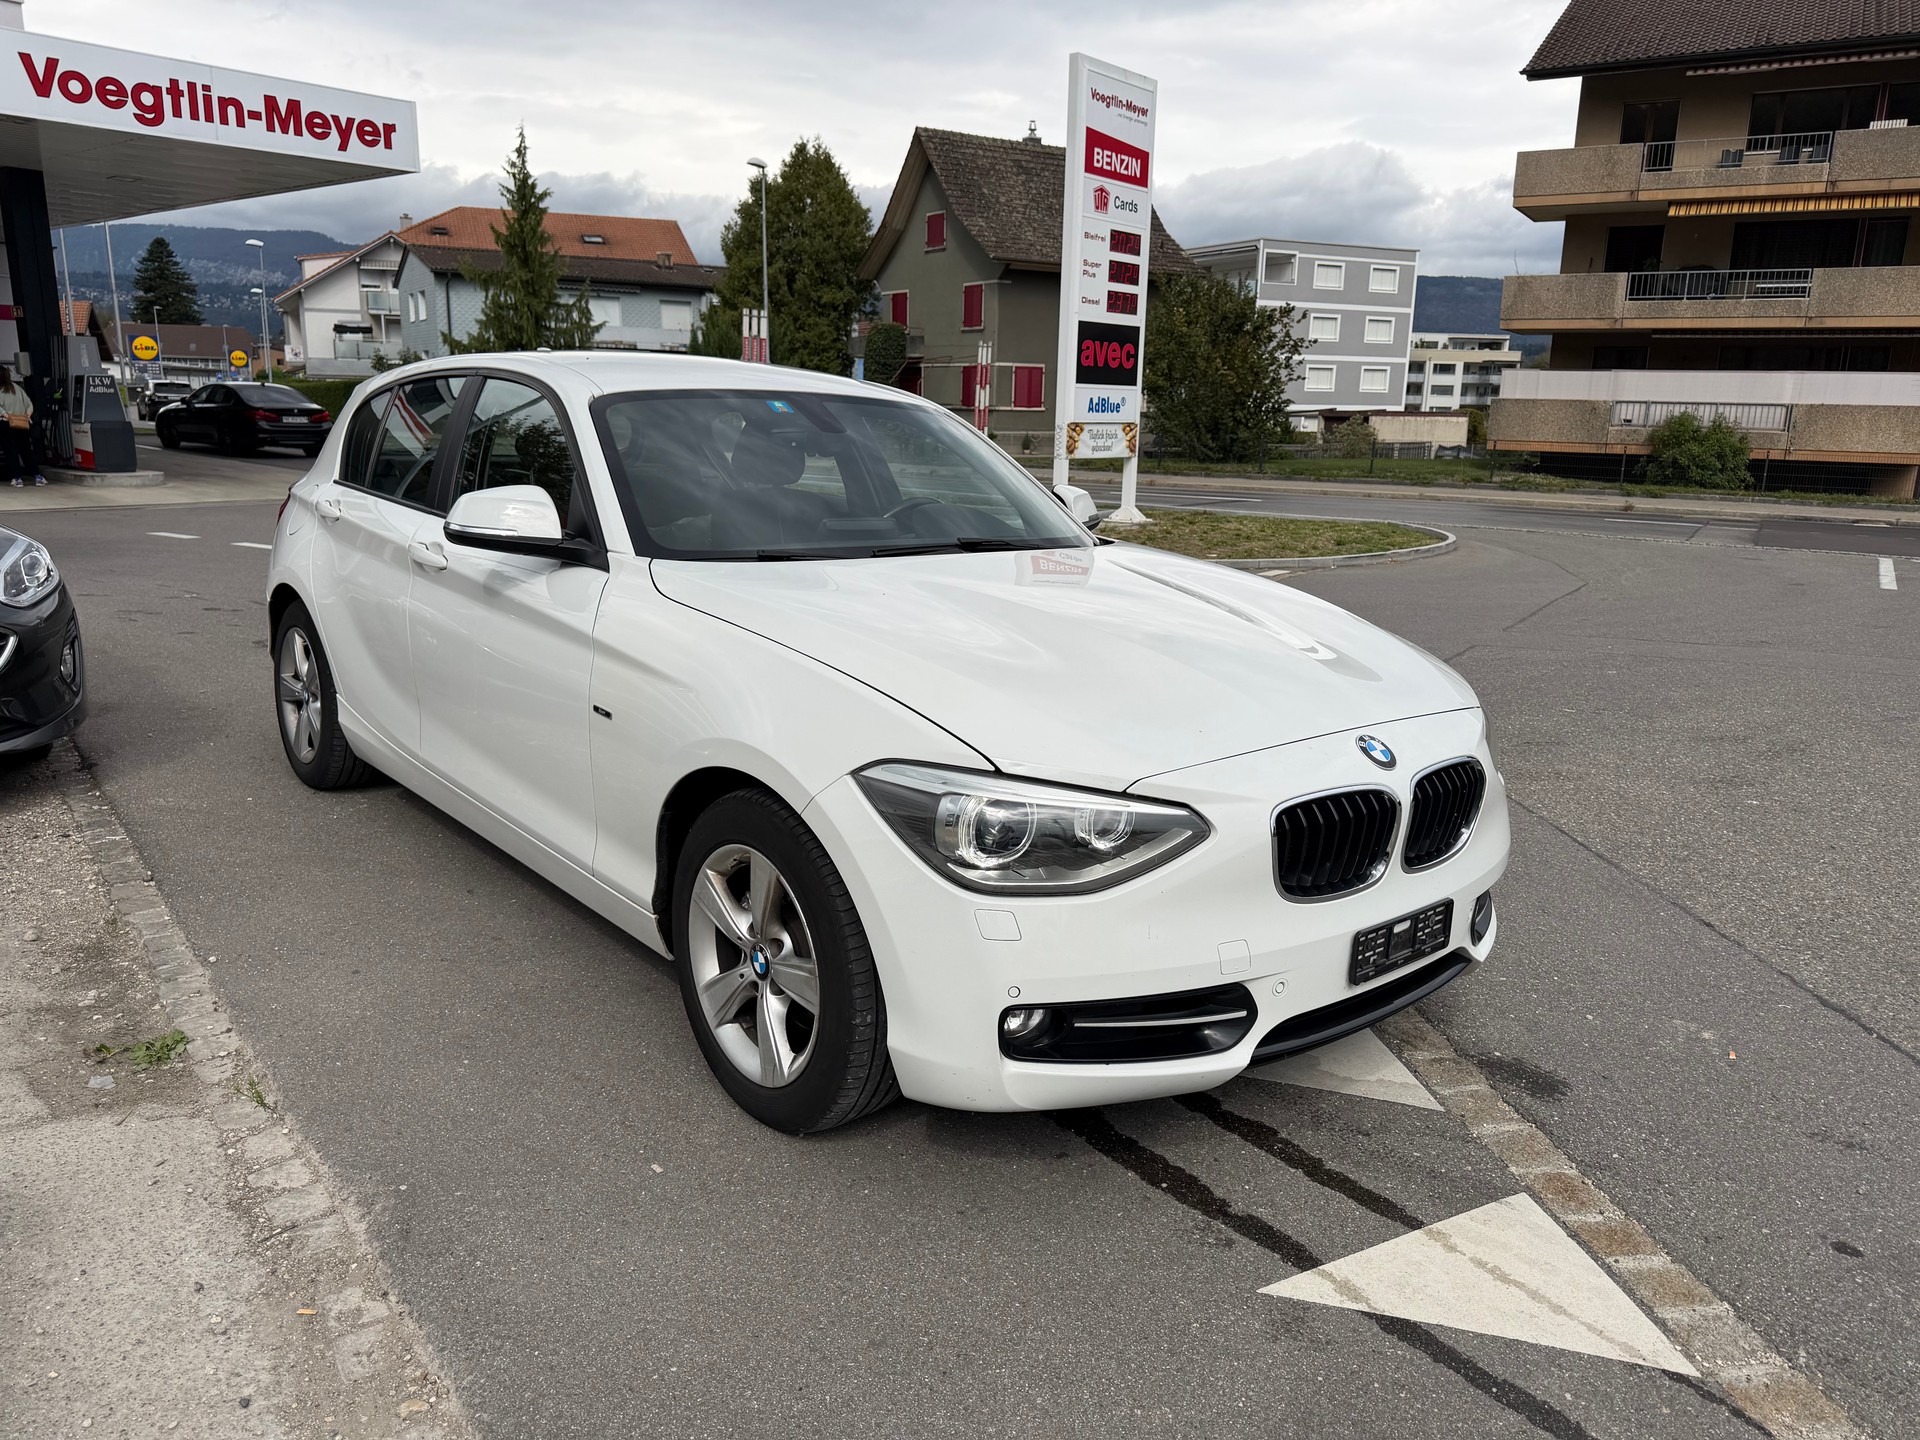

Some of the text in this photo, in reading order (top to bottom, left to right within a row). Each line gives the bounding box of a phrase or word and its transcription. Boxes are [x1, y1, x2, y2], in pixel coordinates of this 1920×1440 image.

[17, 51, 397, 152] Voegtlin-Meyer
[1090, 87, 1149, 118] Voegtlin-Meyer
[1093, 147, 1141, 178] BENZIN
[1113, 195, 1139, 214] Cards
[1084, 231, 1107, 243] Bleifrei
[1083, 259, 1102, 269] Super
[1082, 269, 1096, 278] Plus
[1081, 296, 1101, 306] Diesel
[1081, 339, 1135, 369] avec
[89, 376, 112, 386] LKW
[89, 385, 115, 393] AdBlue
